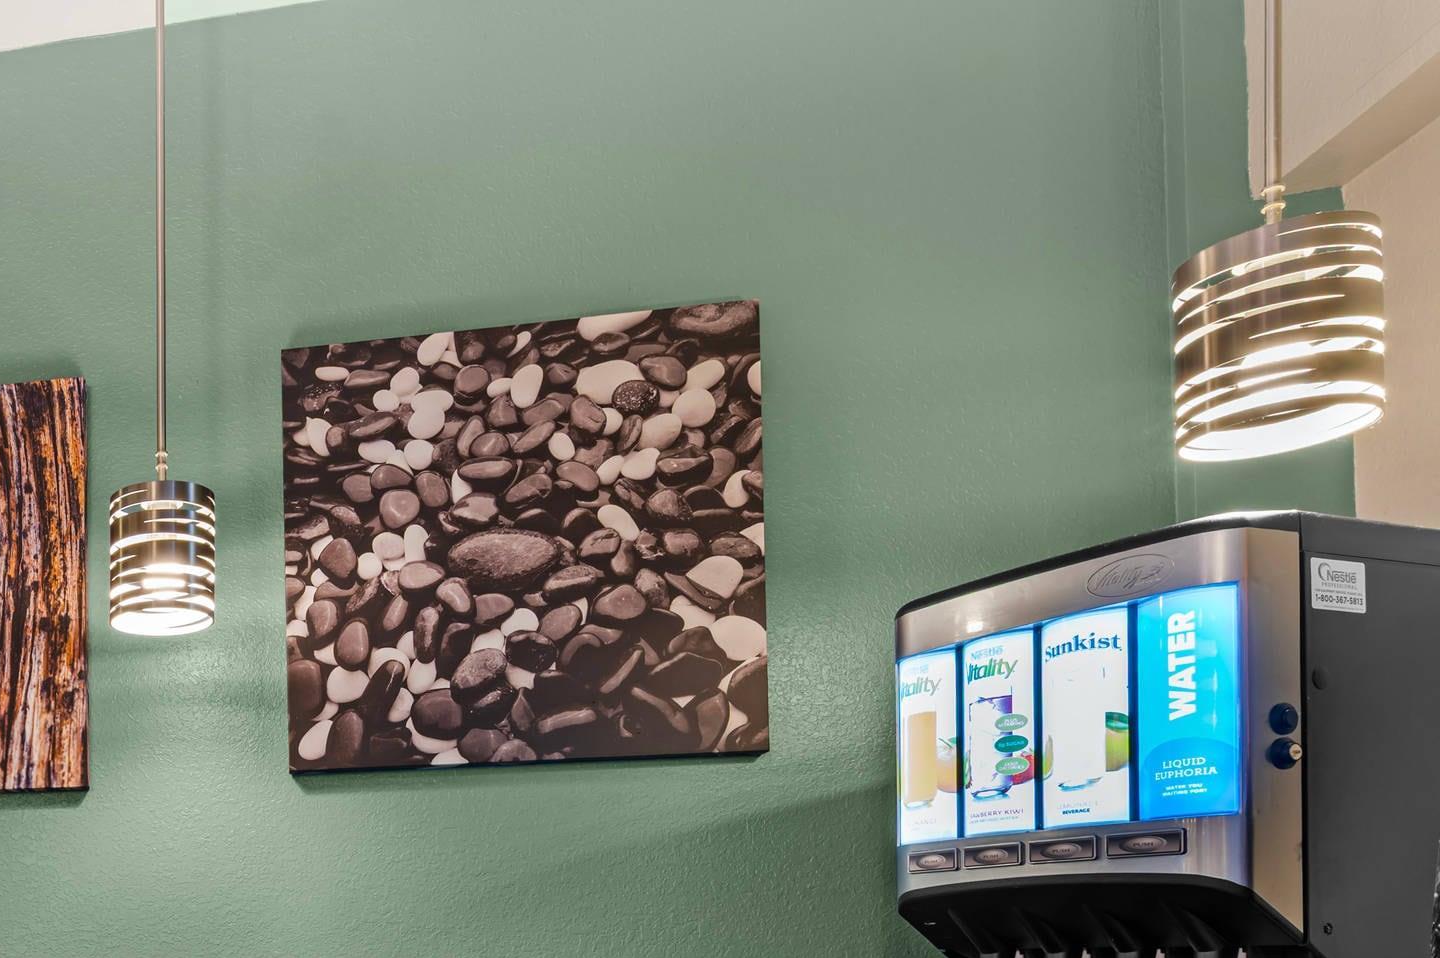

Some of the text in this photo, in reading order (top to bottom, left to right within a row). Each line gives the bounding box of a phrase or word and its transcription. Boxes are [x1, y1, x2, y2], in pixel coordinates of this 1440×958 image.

[1045, 632, 1122, 662] Sunkist
[1168, 610, 1197, 721] WATER
[900, 677, 941, 699] itality
[1155, 766, 1219, 781] EUPHORIA
[1162, 756, 1207, 770] LIQUID
